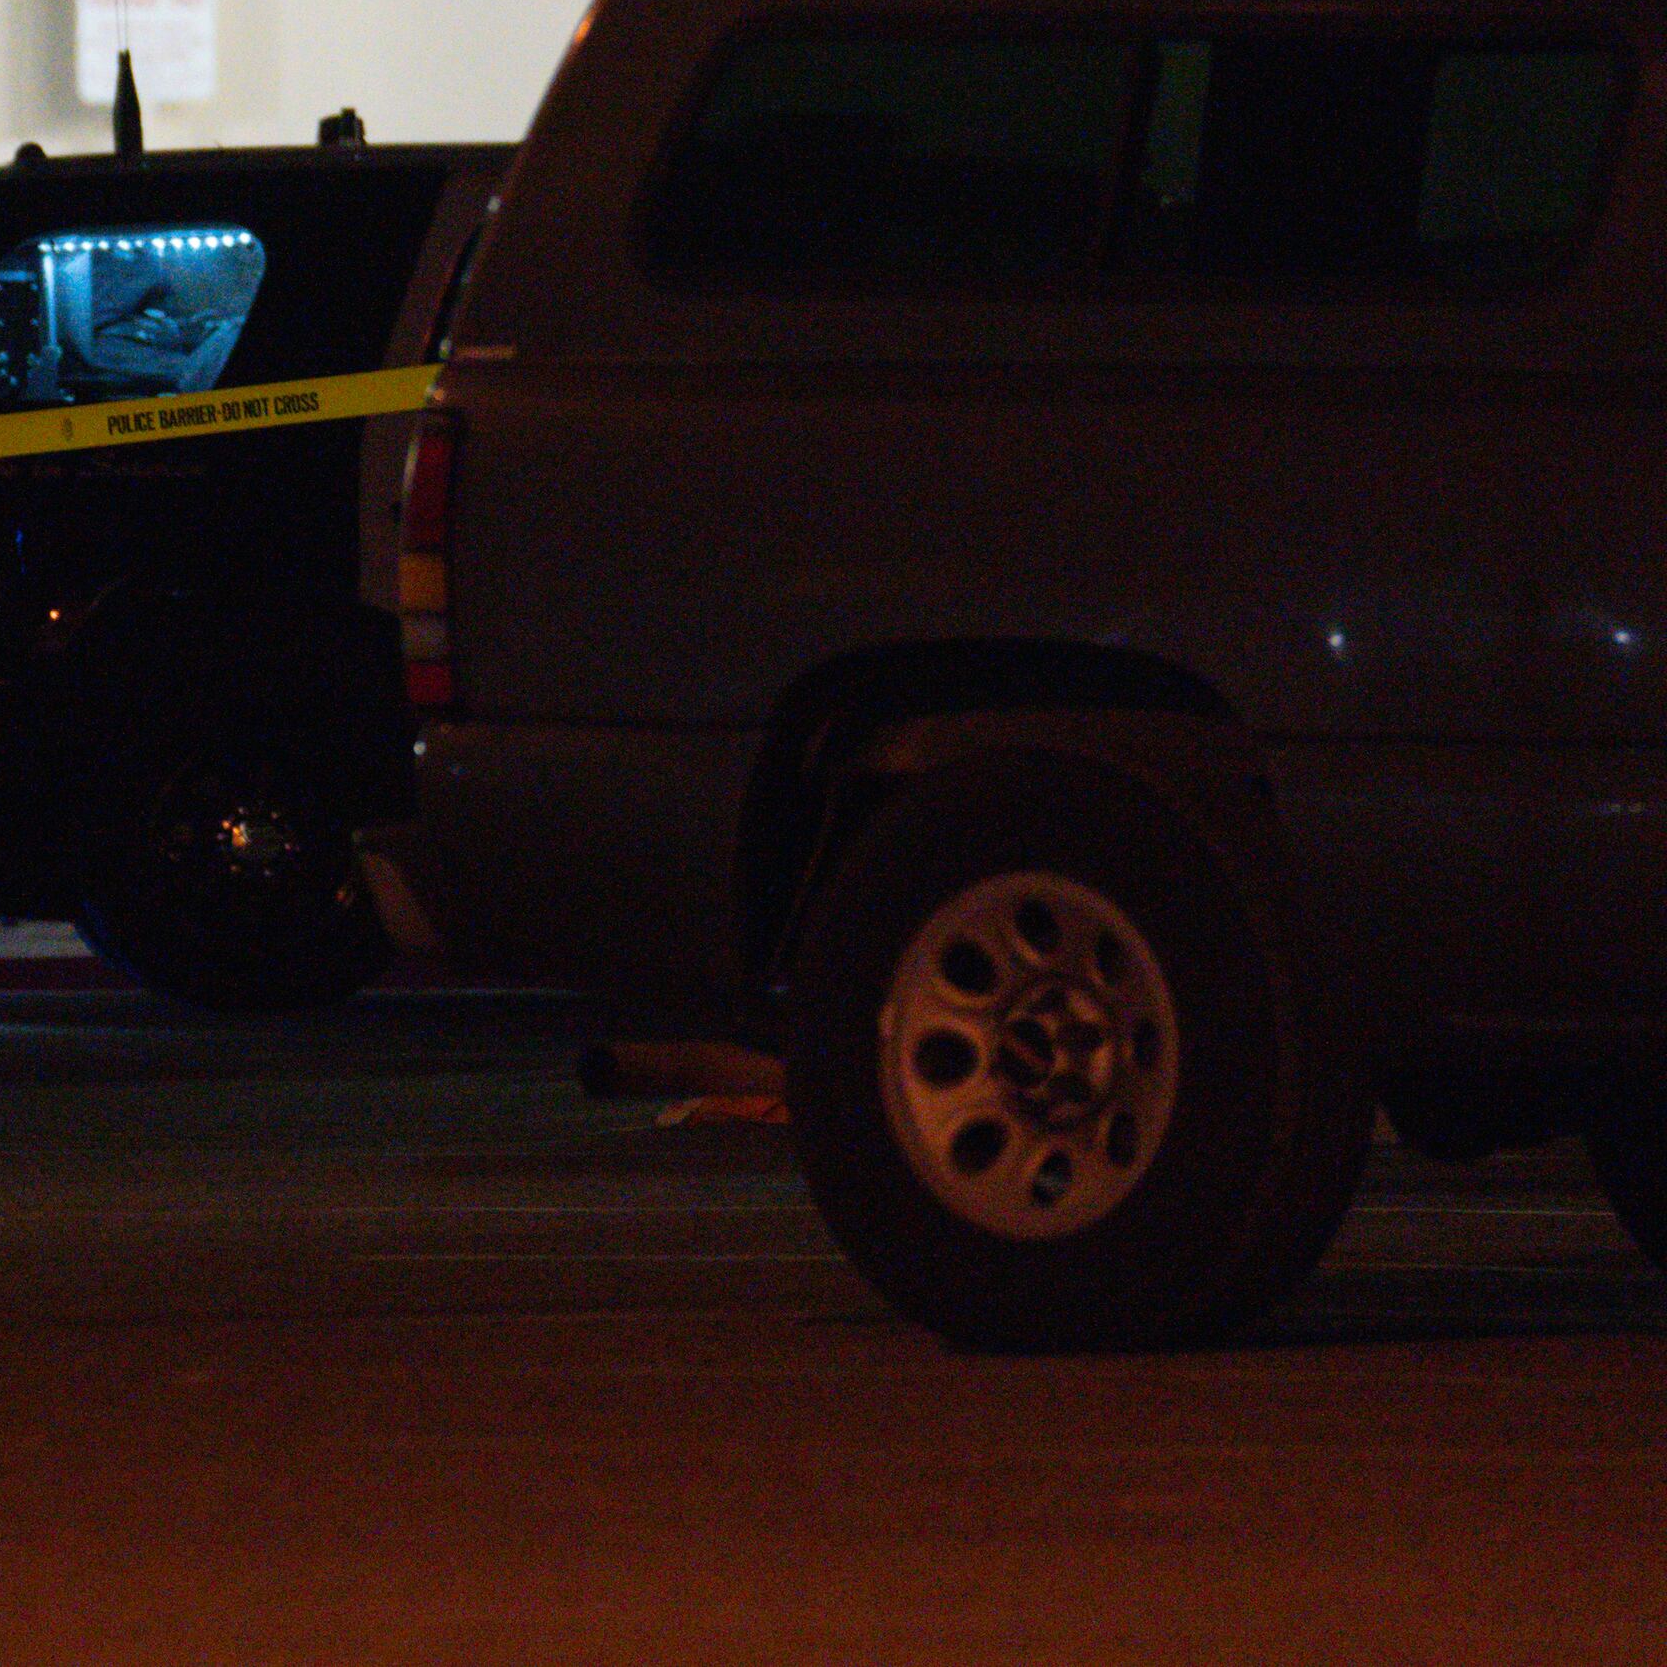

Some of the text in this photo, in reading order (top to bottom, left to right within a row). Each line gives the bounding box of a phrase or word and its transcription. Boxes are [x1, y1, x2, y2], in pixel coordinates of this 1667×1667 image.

[107, 411, 155, 435] POLICE
[243, 397, 270, 420] NOT
[273, 391, 320, 416] CROSS
